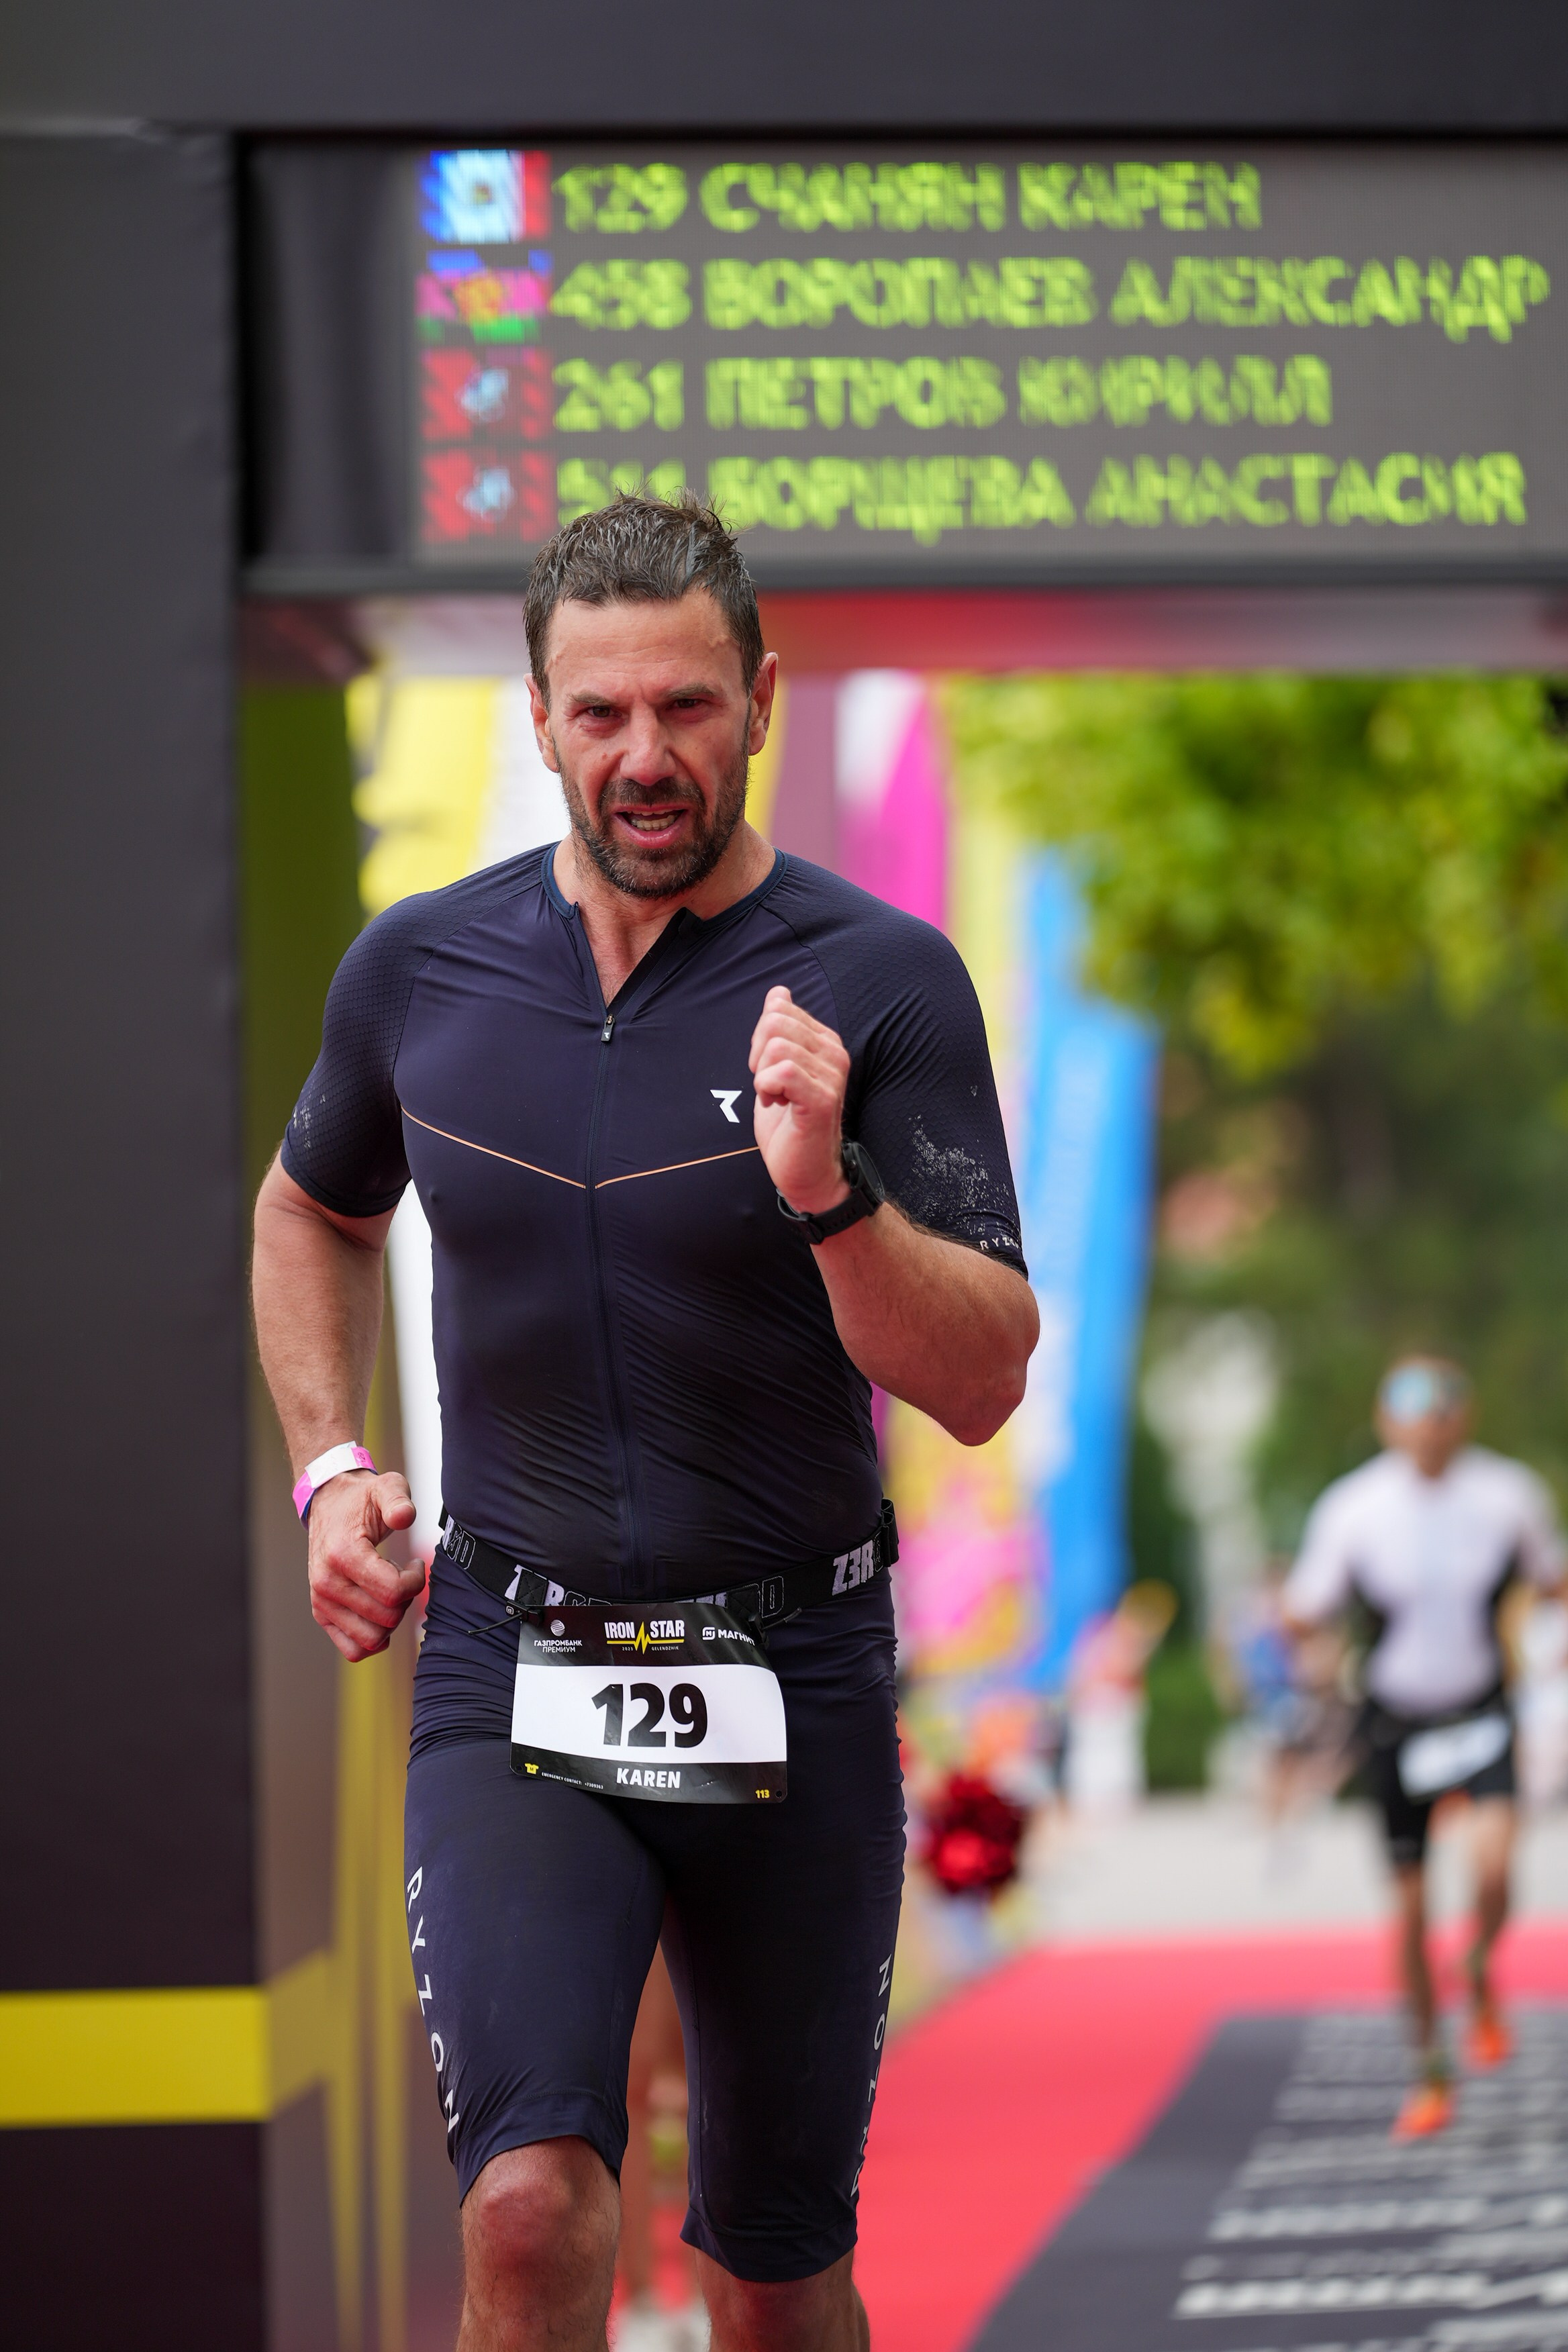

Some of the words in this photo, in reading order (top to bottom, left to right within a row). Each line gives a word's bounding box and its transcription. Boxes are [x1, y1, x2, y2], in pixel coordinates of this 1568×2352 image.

[552, 162, 688, 233] 129
[1017, 160, 1262, 231] КАРЕН
[703, 257, 1097, 329] ВОРОПАЕВ
[1109, 254, 1551, 343] АЛЕКСАНДР
[553, 358, 685, 432] 261
[705, 356, 1007, 430] ПЕТРОВ
[1018, 354, 1332, 428] КИРИЛЛ
[707, 455, 1077, 545] БОРЩЕВА
[1085, 452, 1527, 527] АНАСТАСИЯ
[604, 1622, 636, 1638] IRON
[650, 1620, 685, 1638] STAR
[718, 1629, 755, 1646] МАГНИТ
[591, 1683, 707, 1748] 129
[541, 1772, 564, 1781] EMERGENCY
[616, 1767, 681, 1789] KAREN
[755, 1789, 770, 1798] 113
[407, 1865, 459, 2133] RYZON
